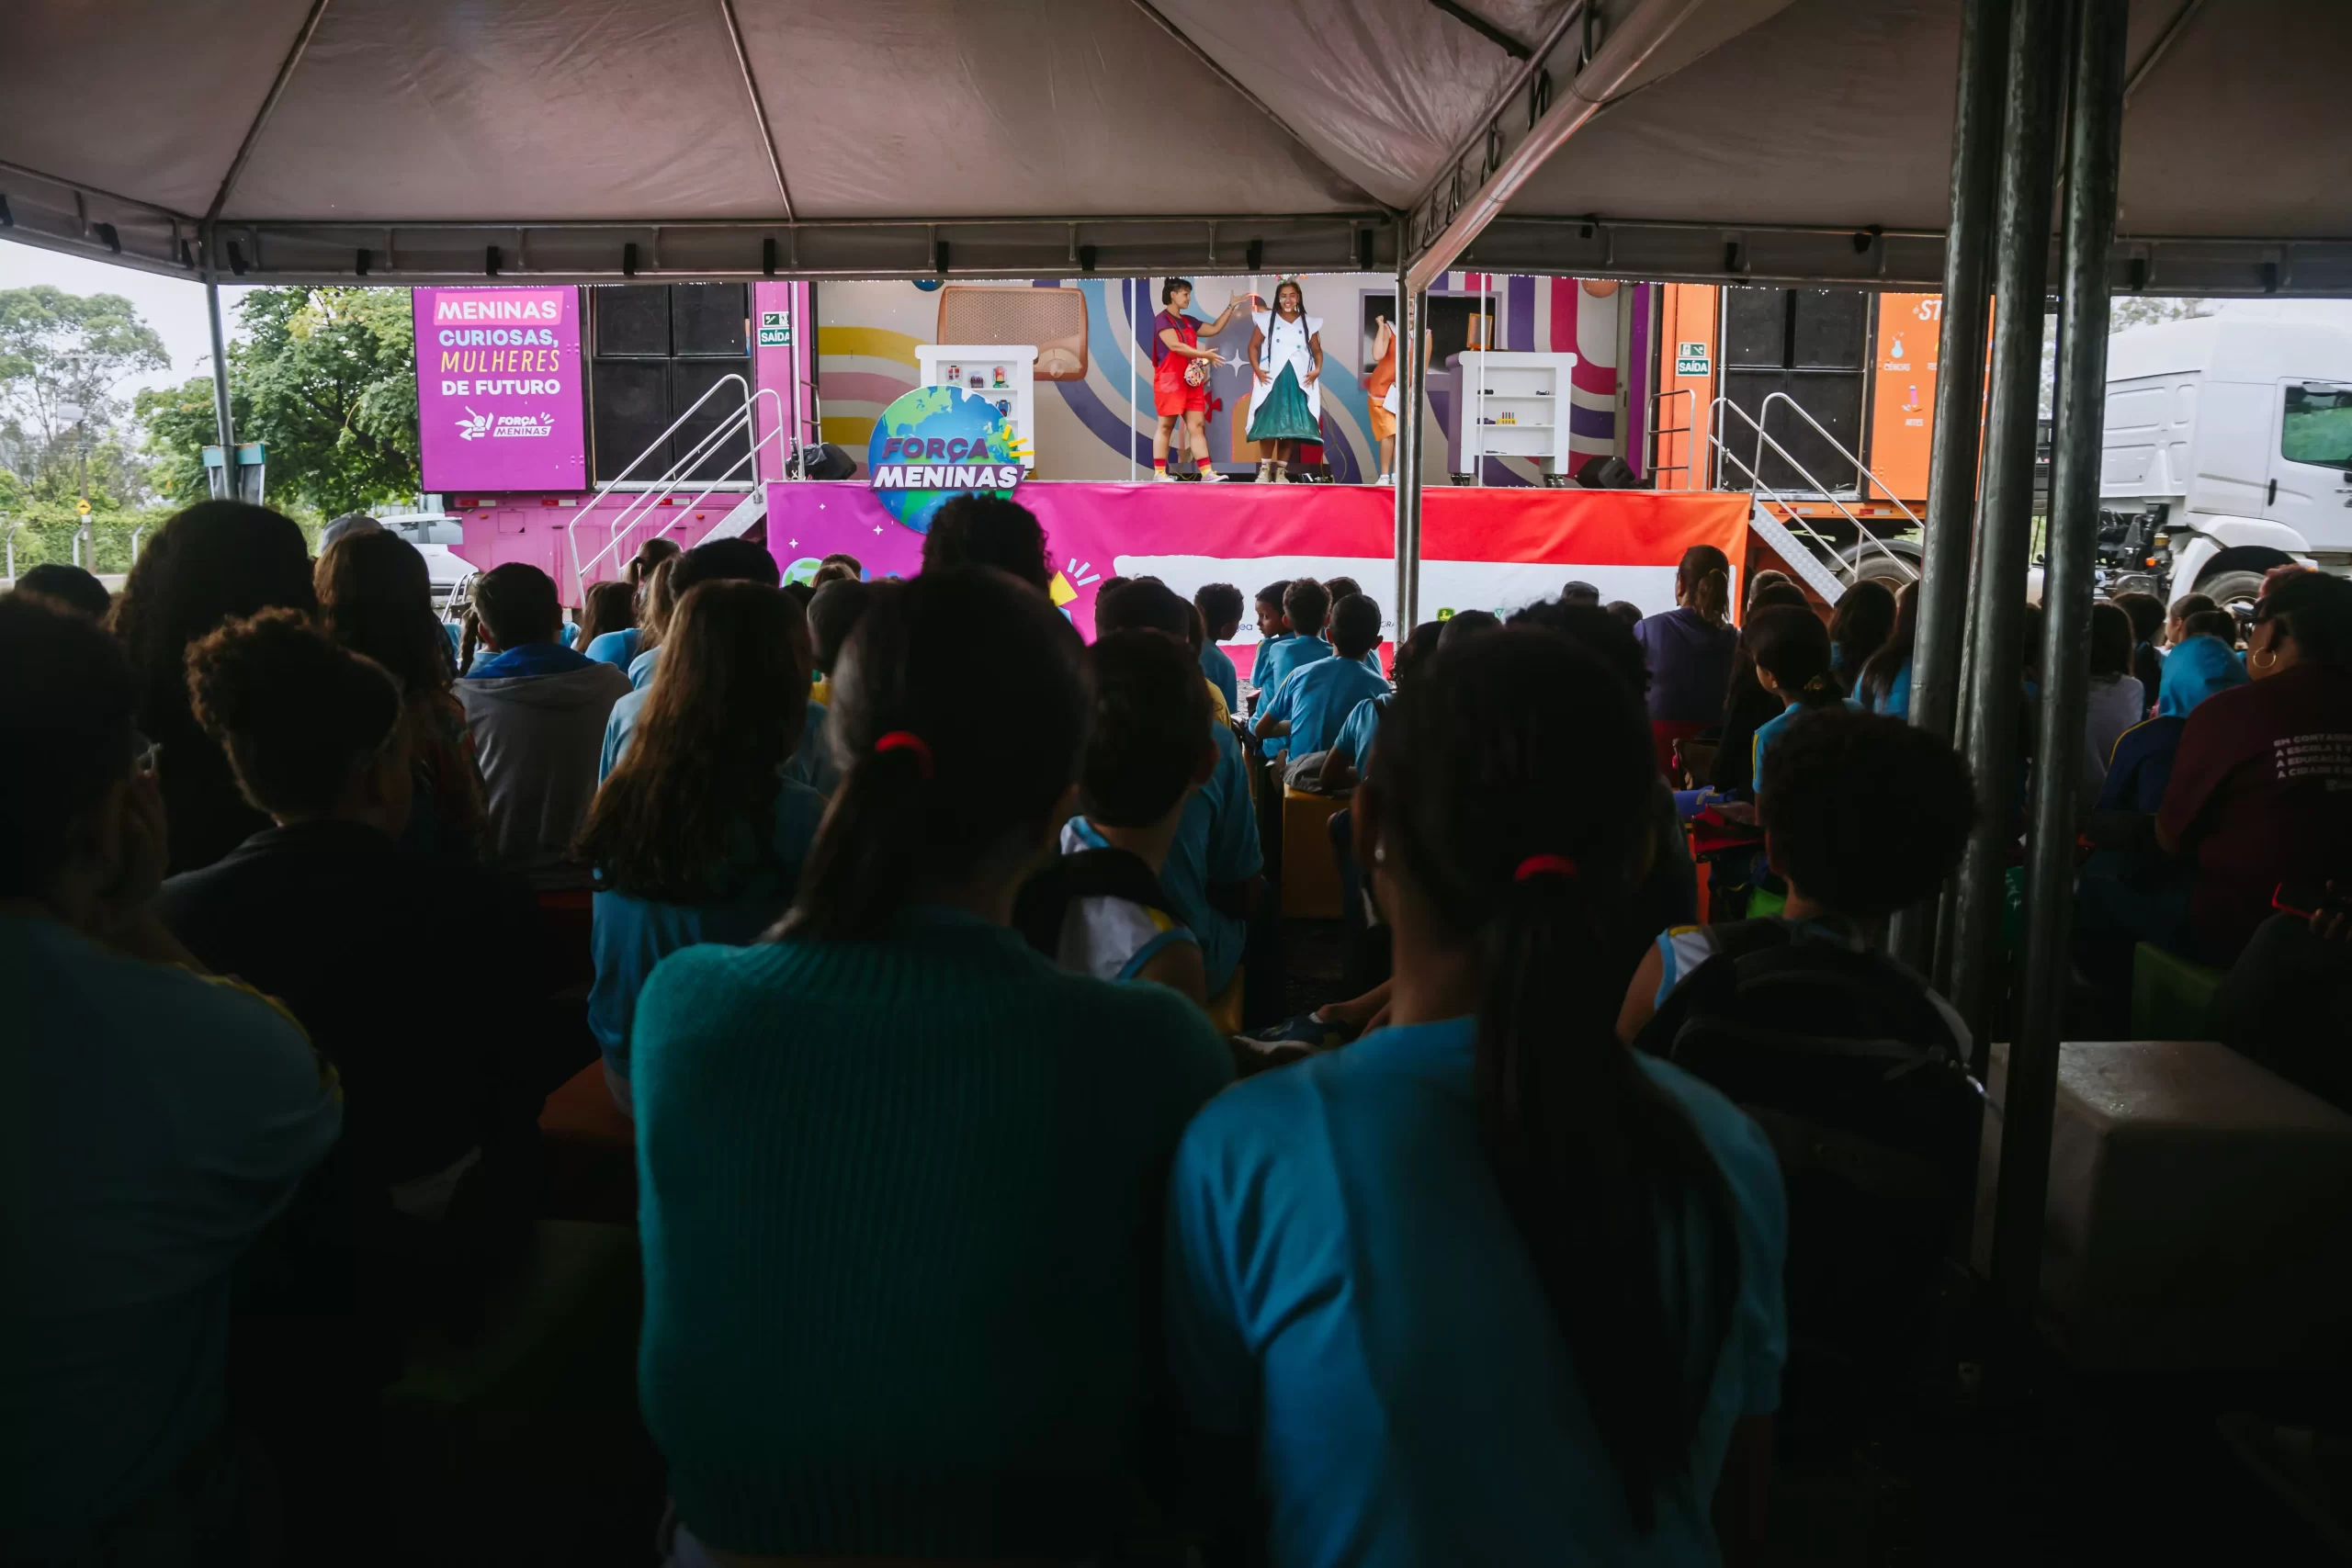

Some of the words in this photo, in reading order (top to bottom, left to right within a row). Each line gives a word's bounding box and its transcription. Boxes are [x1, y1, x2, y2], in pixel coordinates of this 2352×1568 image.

[437, 300, 557, 320] MENINAS
[439, 329, 559, 347] CURIOSAS,
[761, 329, 790, 343] SAÍDA
[441, 350, 560, 373] MULHERES
[1679, 360, 1708, 372] SAÍDA
[442, 380, 469, 396] DE
[475, 379, 561, 396] FUTURO
[497, 416, 537, 427] FORÇA
[496, 427, 548, 435] MENINAS
[882, 437, 989, 464] FORÇA
[873, 466, 1018, 489] MENINAS
[2275, 749, 2284, 758] A
[2276, 760, 2285, 768] A
[2278, 770, 2286, 779] A
